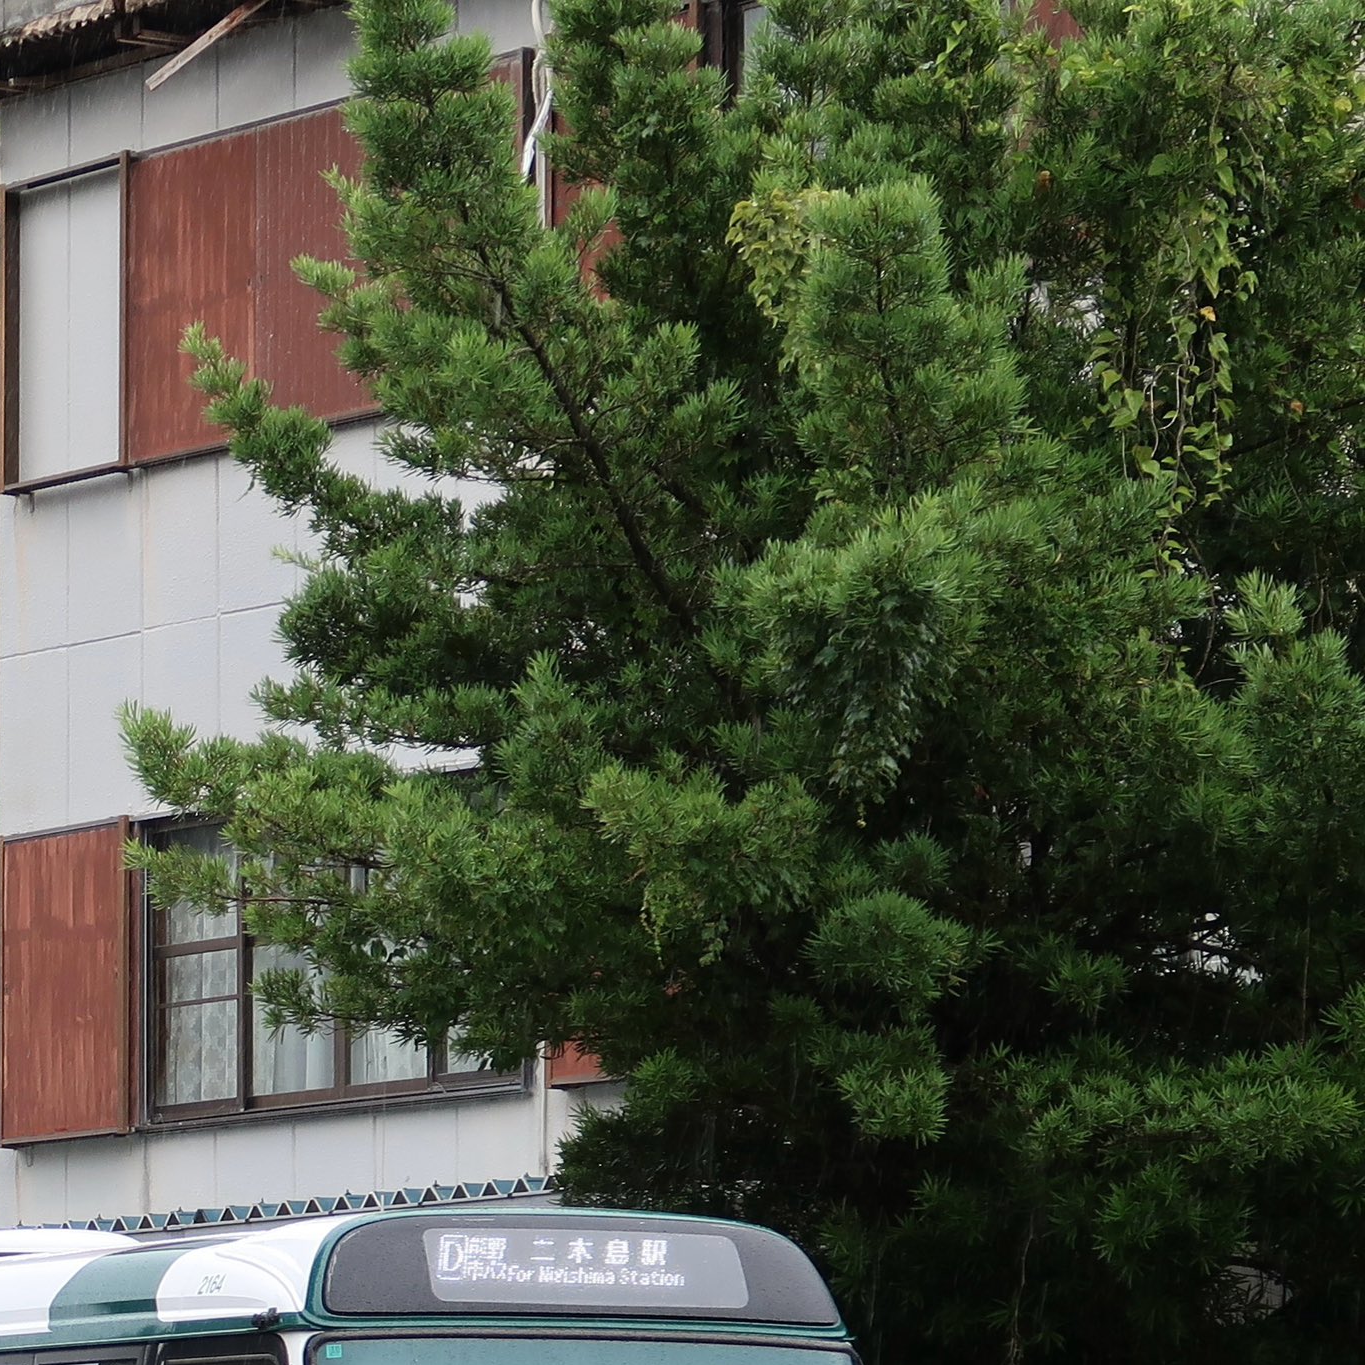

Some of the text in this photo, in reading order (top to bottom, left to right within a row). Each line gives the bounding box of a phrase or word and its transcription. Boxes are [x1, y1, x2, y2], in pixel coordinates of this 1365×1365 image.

[530, 1238, 668, 1266] 二木島駅
[197, 1274, 227, 1295] 2164
[508, 1264, 535, 1282] For
[619, 1268, 685, 1286] Station
